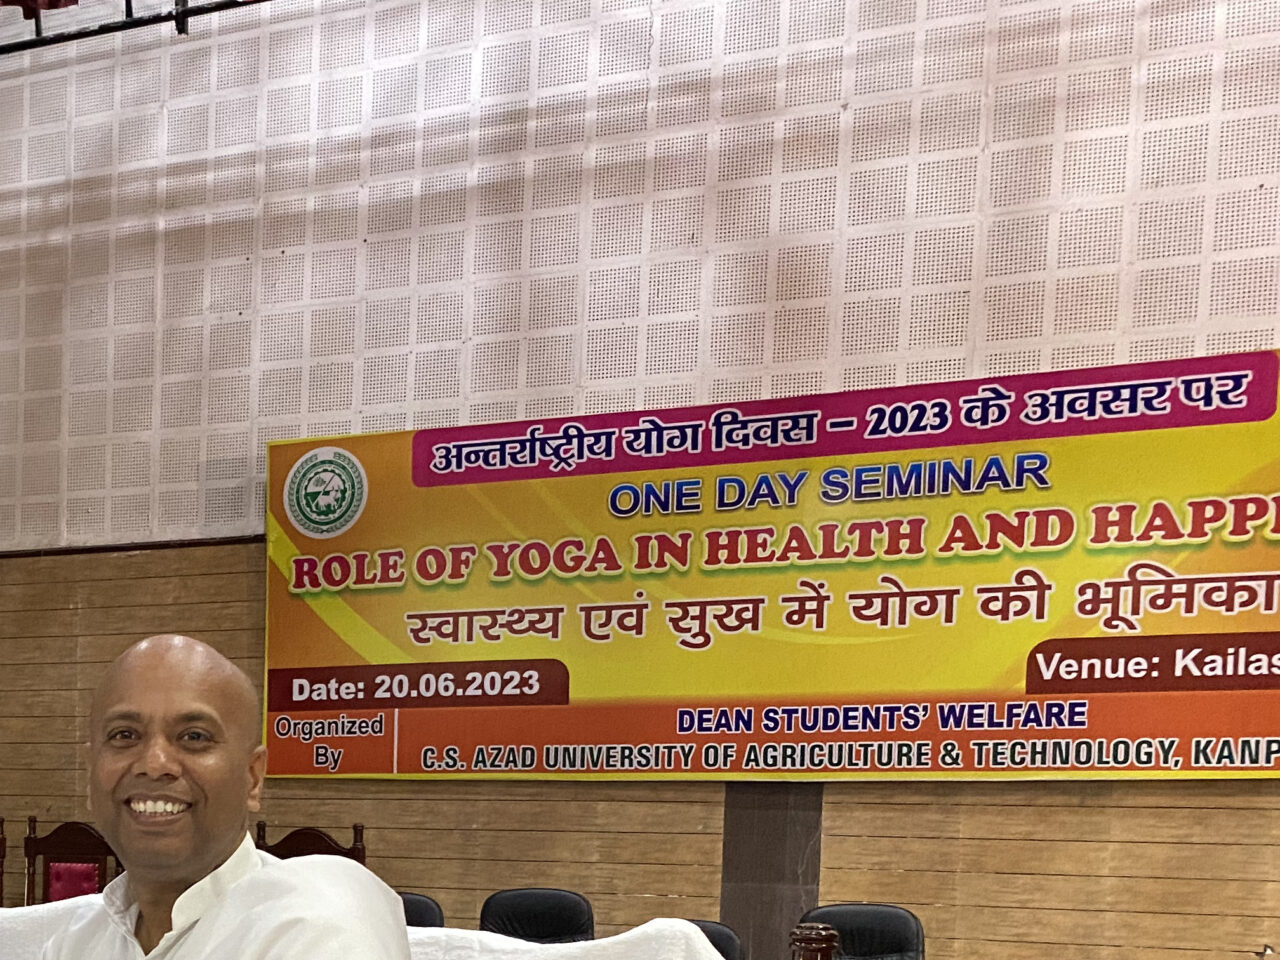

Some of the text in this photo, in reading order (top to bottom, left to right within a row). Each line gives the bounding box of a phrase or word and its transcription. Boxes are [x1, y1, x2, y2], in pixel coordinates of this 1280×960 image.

[431, 424, 616, 470] अन्तर्राष्ट्रीय
[623, 418, 704, 458] योग
[710, 409, 820, 450] दिवस
[865, 400, 951, 439] 2023
[961, 386, 1013, 429] के
[1022, 379, 1174, 424] अवसर
[1181, 371, 1253, 410] पर
[609, 453, 1050, 517] ONE DAY SEMINAR
[290, 550, 405, 594] ROLE
[414, 545, 476, 585] OF
[486, 537, 622, 582] YOGA
[634, 532, 694, 571] IN
[703, 516, 926, 567] HEALTH
[938, 507, 1076, 555] AND
[405, 561, 1277, 649] स्वास्थ्य एवं सुख में योग की भूमिका
[1035, 651, 1160, 681] Venue:
[291, 669, 540, 702] Date: 20.06.2023
[274, 714, 385, 741] Organized
[677, 707, 753, 735] DEAN
[938, 700, 1089, 730] WELFARE
[312, 745, 344, 772] By
[420, 737, 1280, 771] C.S. AZAD UNIVERSITY OF AGRICULTURE & TECHNOLOGY, KANP
